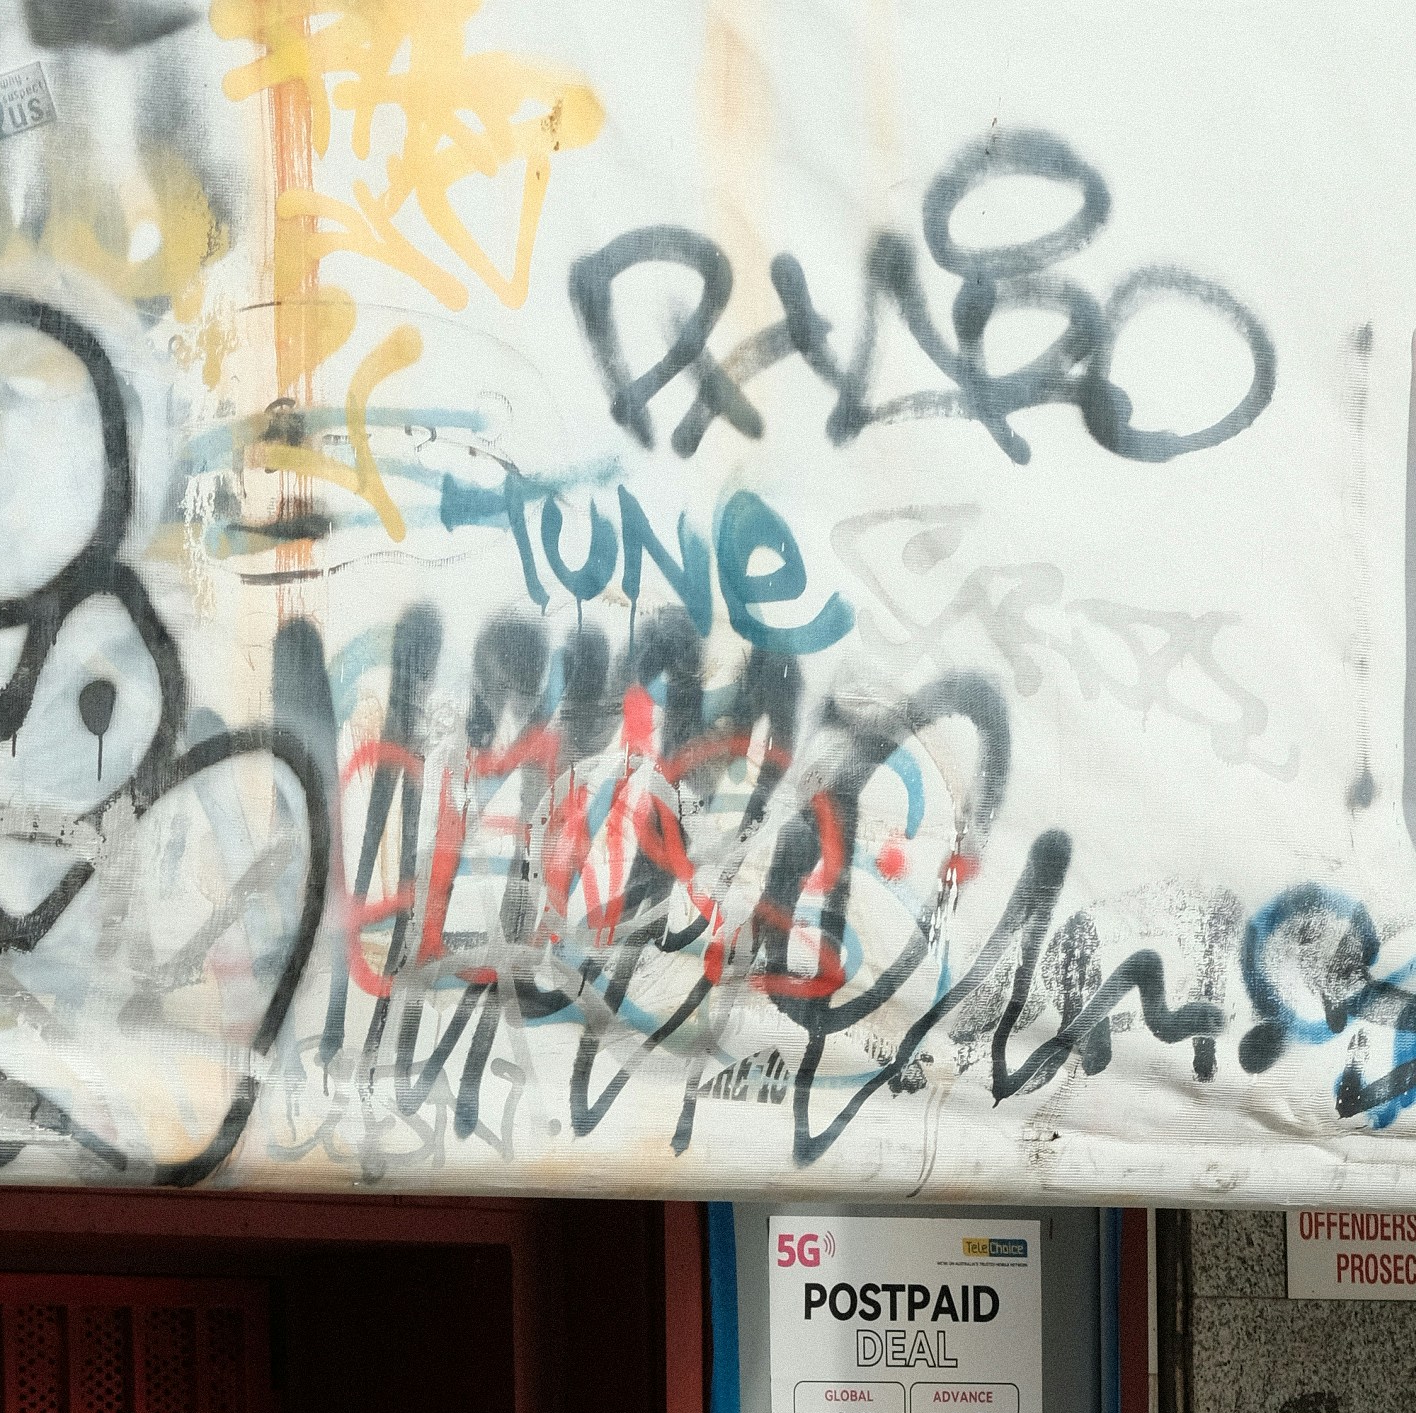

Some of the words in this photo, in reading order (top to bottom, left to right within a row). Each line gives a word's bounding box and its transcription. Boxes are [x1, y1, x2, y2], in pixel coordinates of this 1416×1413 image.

[777, 1233, 821, 1268] 5G
[803, 1282, 1000, 1323] POSTPAID
[856, 1329, 958, 1368] DEAL
[824, 1389, 874, 1402] GLOBAL
[933, 1391, 993, 1404] ADVANCE
